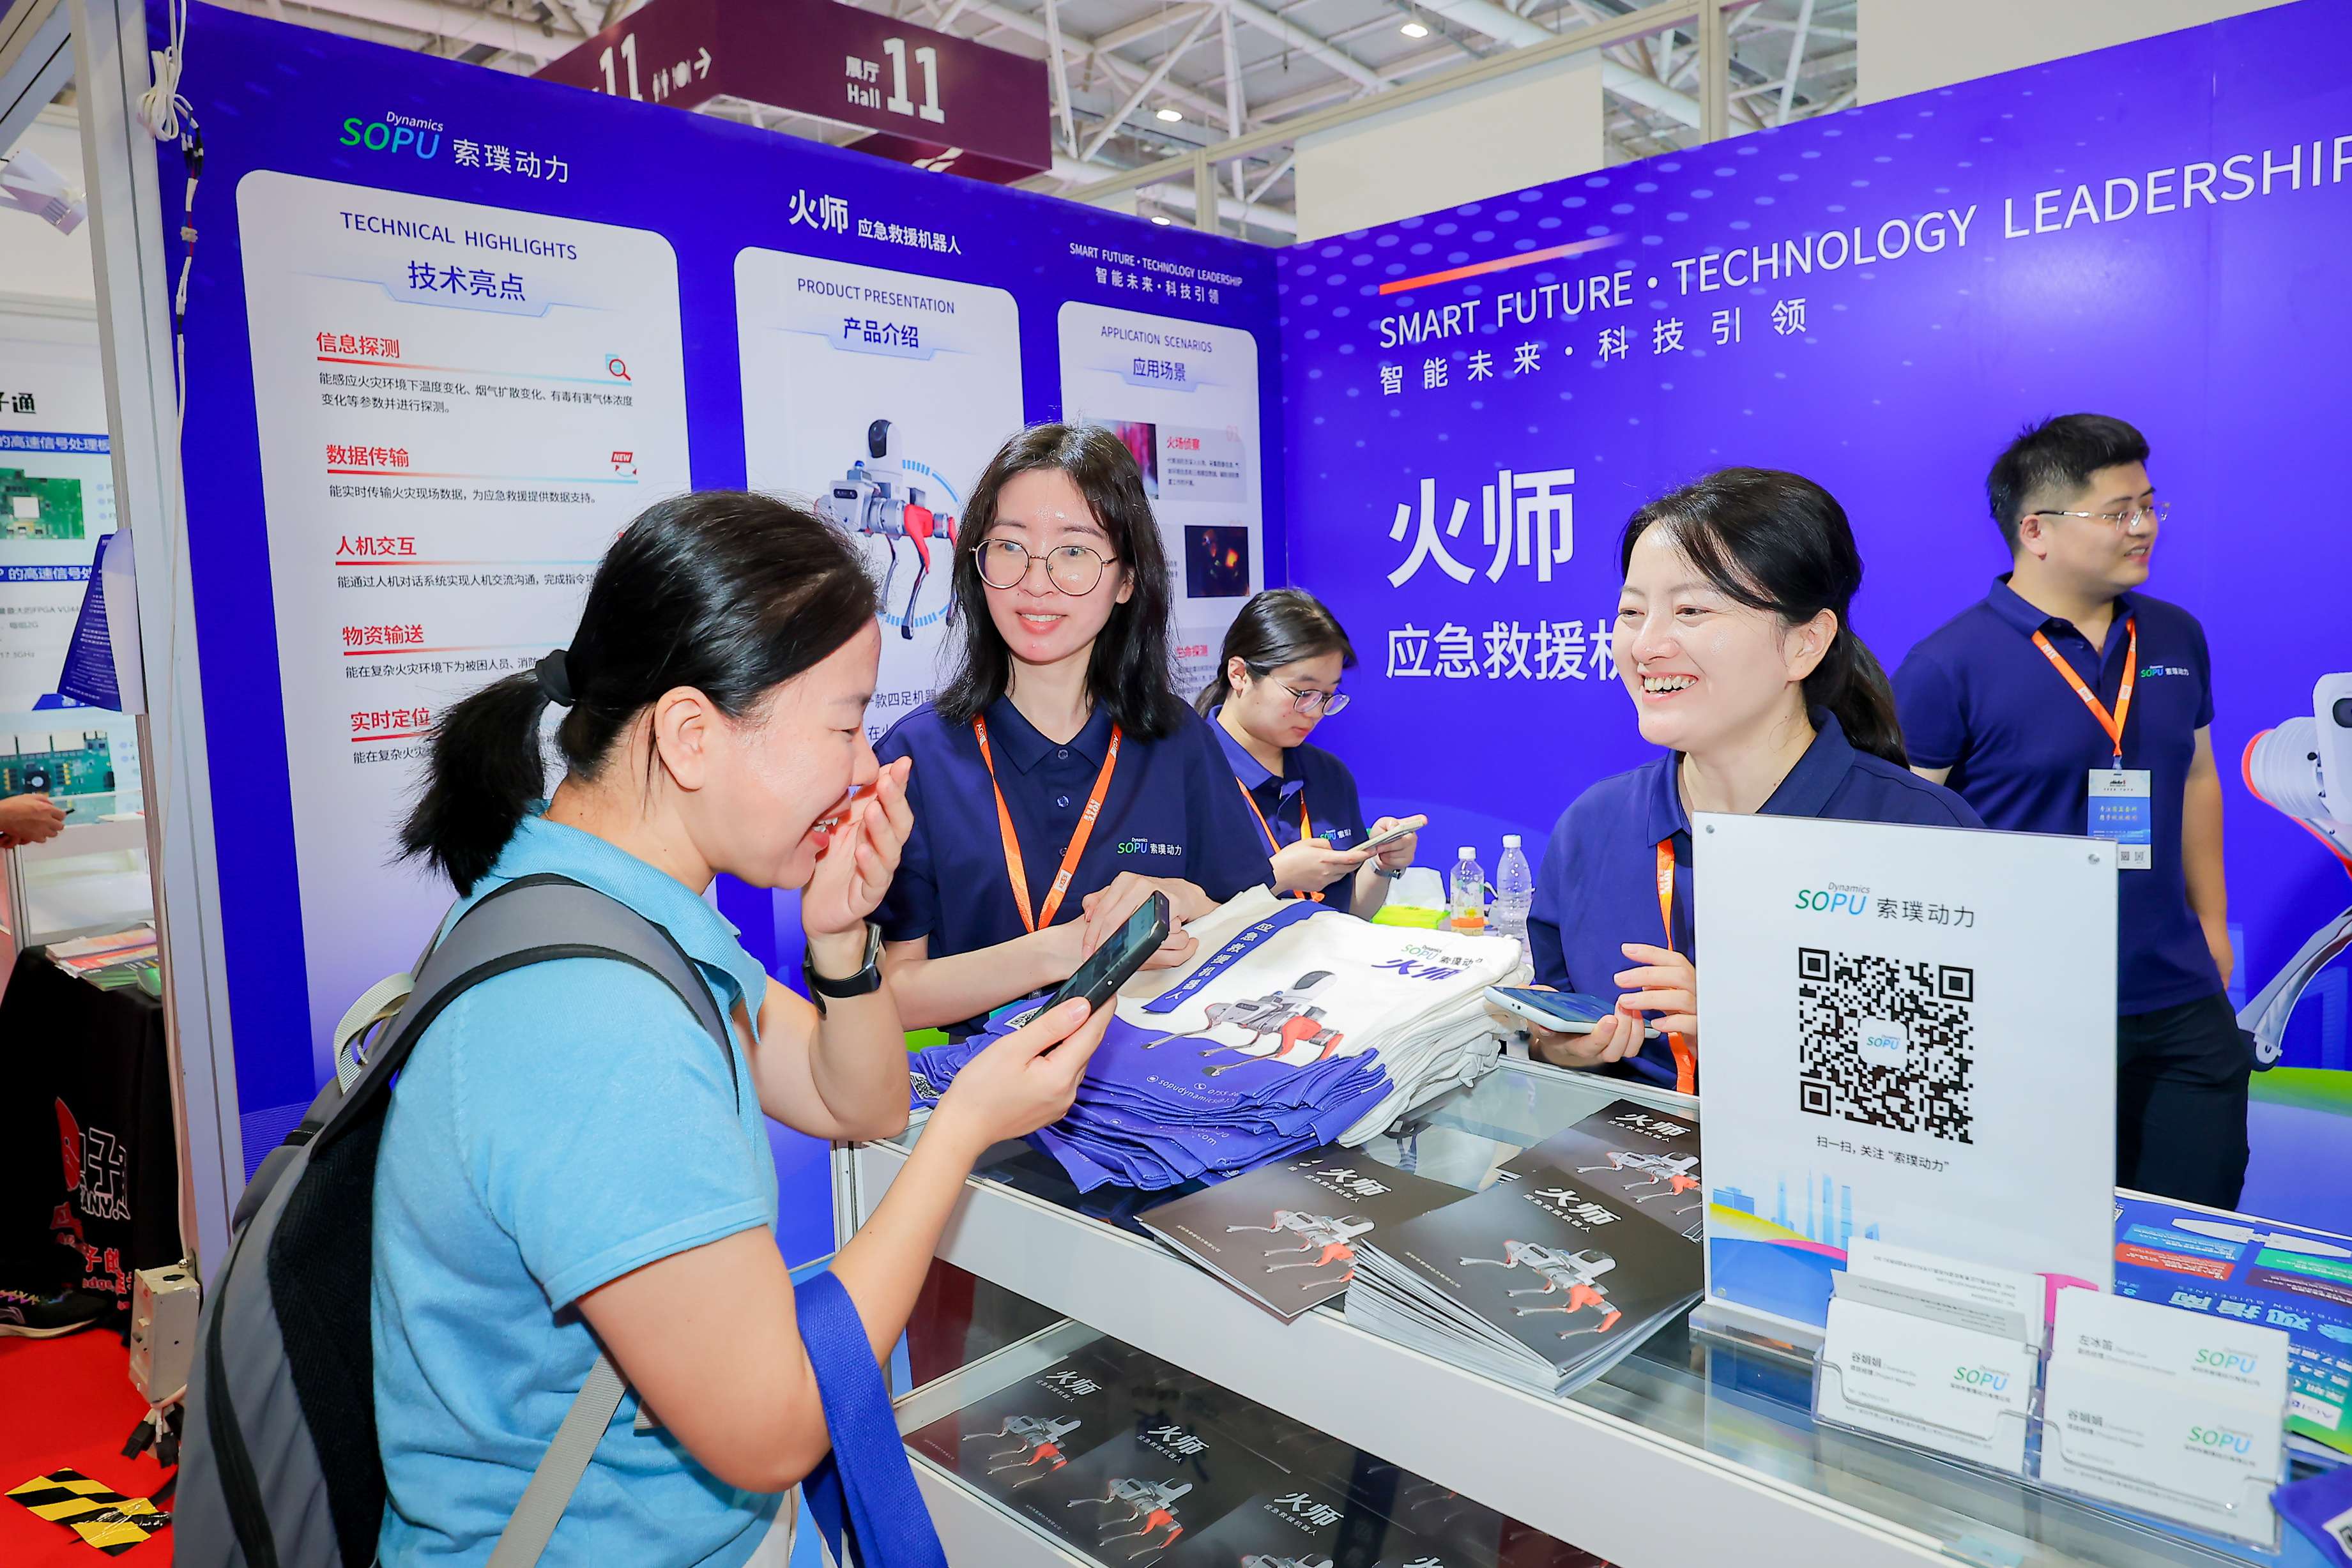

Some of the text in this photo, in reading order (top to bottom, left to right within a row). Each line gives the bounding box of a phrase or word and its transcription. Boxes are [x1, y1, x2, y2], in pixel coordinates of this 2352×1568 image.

[599, 33, 643, 102] 11
[846, 56, 879, 84] 展厅
[847, 37, 945, 125] Hall 11
[386, 111, 444, 132] Dynamics
[339, 118, 569, 184] SOPU 索璞动力
[340, 211, 577, 261] TECHNICAL HIGHLIGHTS
[788, 189, 962, 255] 火师 应急救援机器人
[1069, 242, 1242, 287] SMART FUTURE TECHNOLOGY LEADERSHIP
[1378, 300, 1481, 350] SMART
[1495, 269, 1634, 329] FUTURE
[1672, 204, 1978, 296] TECHNOLOGY
[408, 260, 526, 301] 技术亮点
[797, 277, 955, 315] PRODUCT PRESENTATION
[316, 331, 401, 359] 信息探测
[843, 317, 919, 349] 产品介绍
[1101, 326, 1213, 353] APPLICATION SCENARIOS
[1133, 358, 1186, 382] 应用场景
[319, 372, 634, 407] 能感应火灾环境下温度变化、烟气扩散变化、有毒有害气体浓度
[321, 393, 450, 414] 变化等参数并进行探测。
[326, 444, 409, 468] 数据传输
[613, 452, 632, 462] NEW
[1386, 468, 1576, 589] 火师
[335, 535, 417, 556] 人机交互
[342, 623, 424, 646] 物资输送
[346, 657, 546, 679] 能在复杂火灾环境下为被困人员、消防
[2141, 668, 2164, 678] SOPU
[351, 706, 430, 732] 实时定位
[1117, 842, 1148, 855] SOPU
[1828, 881, 1871, 894] Dynamics
[1794, 889, 1974, 928] SOPU 索璞动力
[1401, 944, 1439, 961] SOPU
[1866, 1036, 1900, 1050] SOPU
[1615, 1113, 1691, 1137] 火师
[1316, 1168, 1392, 1197] 火师
[1534, 1187, 1623, 1226] 火师
[2195, 1348, 2257, 1374] SOPU
[1046, 1370, 1103, 1396] 火师
[1953, 1366, 2008, 1392] SOPU
[1147, 1425, 1210, 1455] 火师
[2187, 1426, 2252, 1455] SOPU
[1273, 1492, 1344, 1526] 火师
